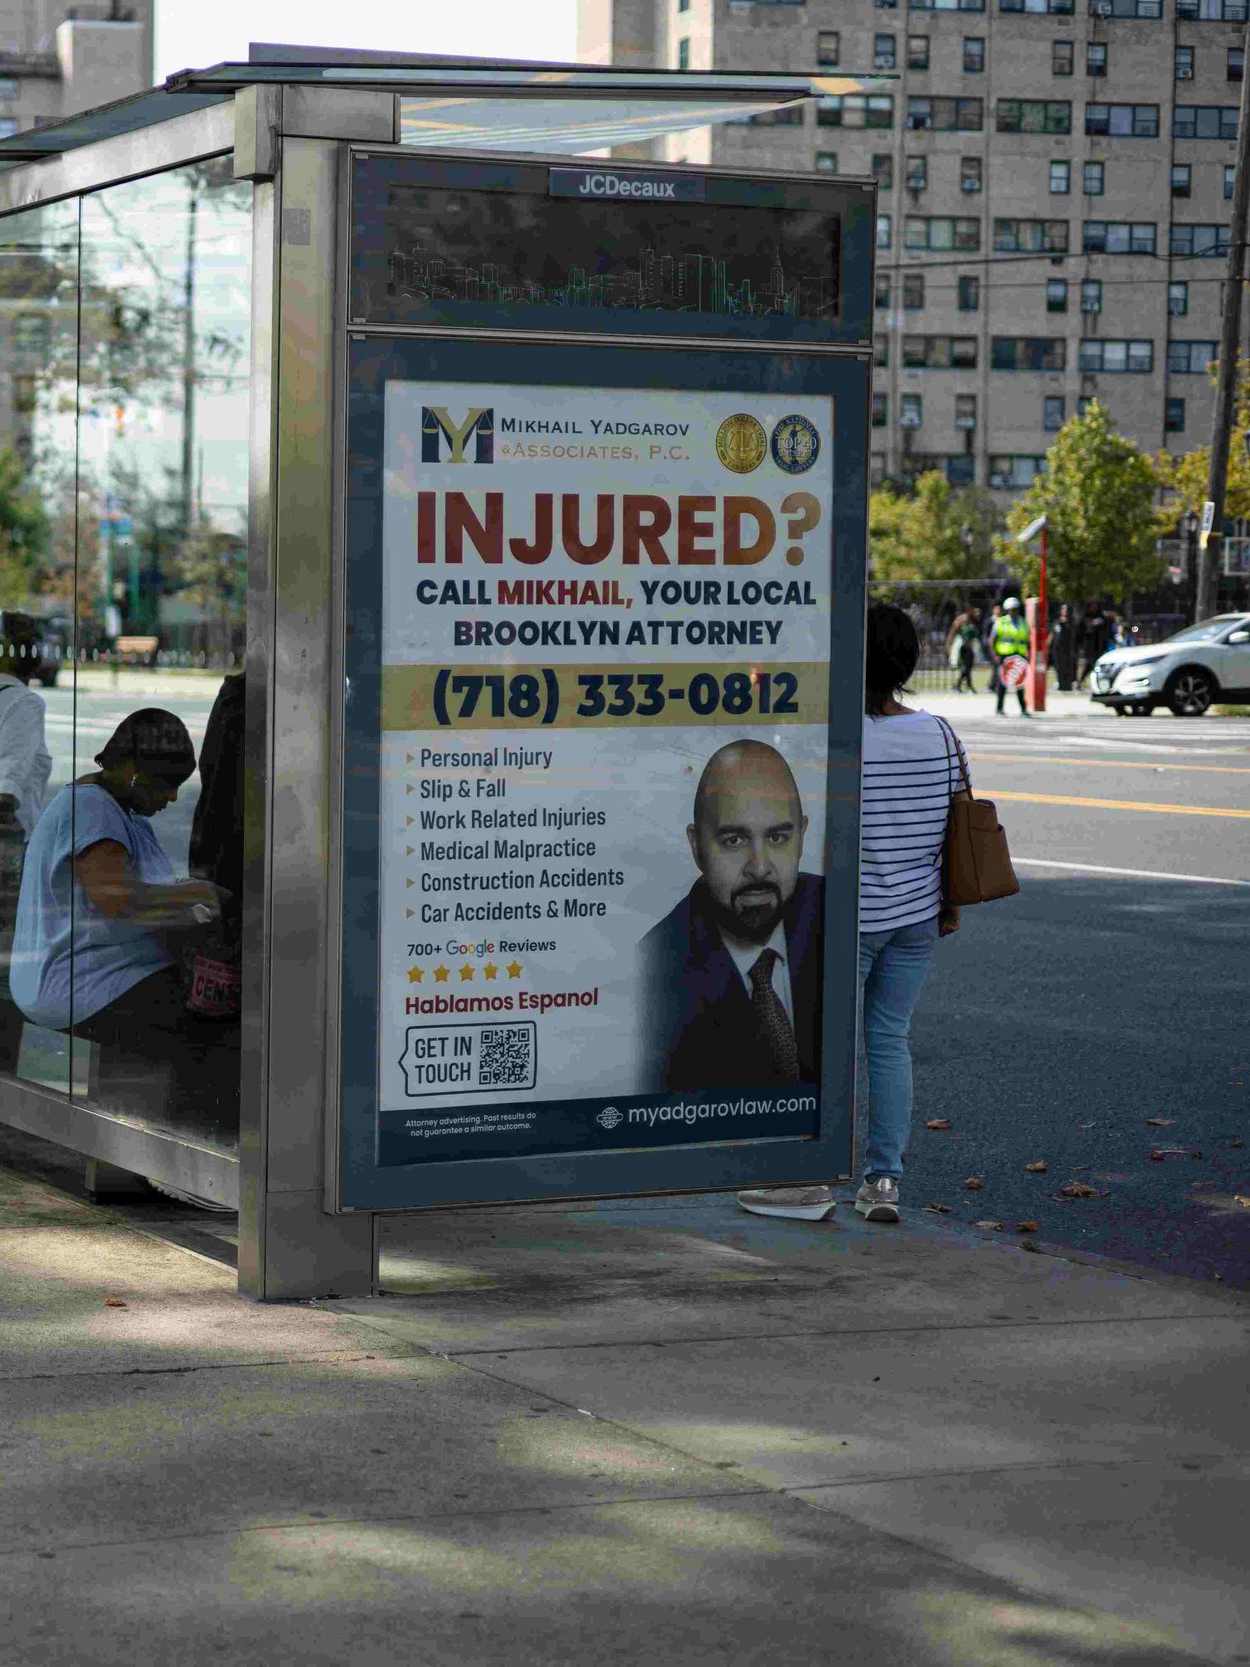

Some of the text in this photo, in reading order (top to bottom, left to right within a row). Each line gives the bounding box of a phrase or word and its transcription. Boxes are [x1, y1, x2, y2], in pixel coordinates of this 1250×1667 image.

[579, 174, 675, 198] JCDecaux
[501, 417, 690, 437] MIKHAIL YADGAROV
[649, 444, 691, 461] P.C.
[417, 491, 822, 566] INJURED?
[416, 579, 817, 609] CALL MIKHAIL, YOUR LOCAL
[454, 620, 784, 646] BROOKLYN ATTORNEY
[433, 668, 800, 726] (718) 333-0812
[420, 747, 553, 770] Personal Injury
[420, 778, 506, 802] Slip & Fall
[420, 806, 607, 831] Work Related Injuries
[421, 837, 597, 862] Medical Malpractice
[421, 867, 625, 892] Construction Accidents
[421, 898, 607, 923] Car Accidents & More
[407, 938, 557, 958] 700+ Google Reviews
[405, 987, 599, 1015] Hablamos Espanol
[414, 1036, 473, 1059] GET IN
[414, 1062, 472, 1084] TOUCH
[405, 1118, 438, 1129] Attorney
[483, 1113, 500, 1122] Past
[500, 1112, 526, 1121] results
[526, 1111, 537, 1120] do
[629, 1097, 816, 1127] myadgarovlaw.com
[410, 1128, 424, 1137] not
[424, 1126, 463, 1138] guarantee
[470, 1123, 496, 1133] similar
[497, 1122, 532, 1132] outcome.
